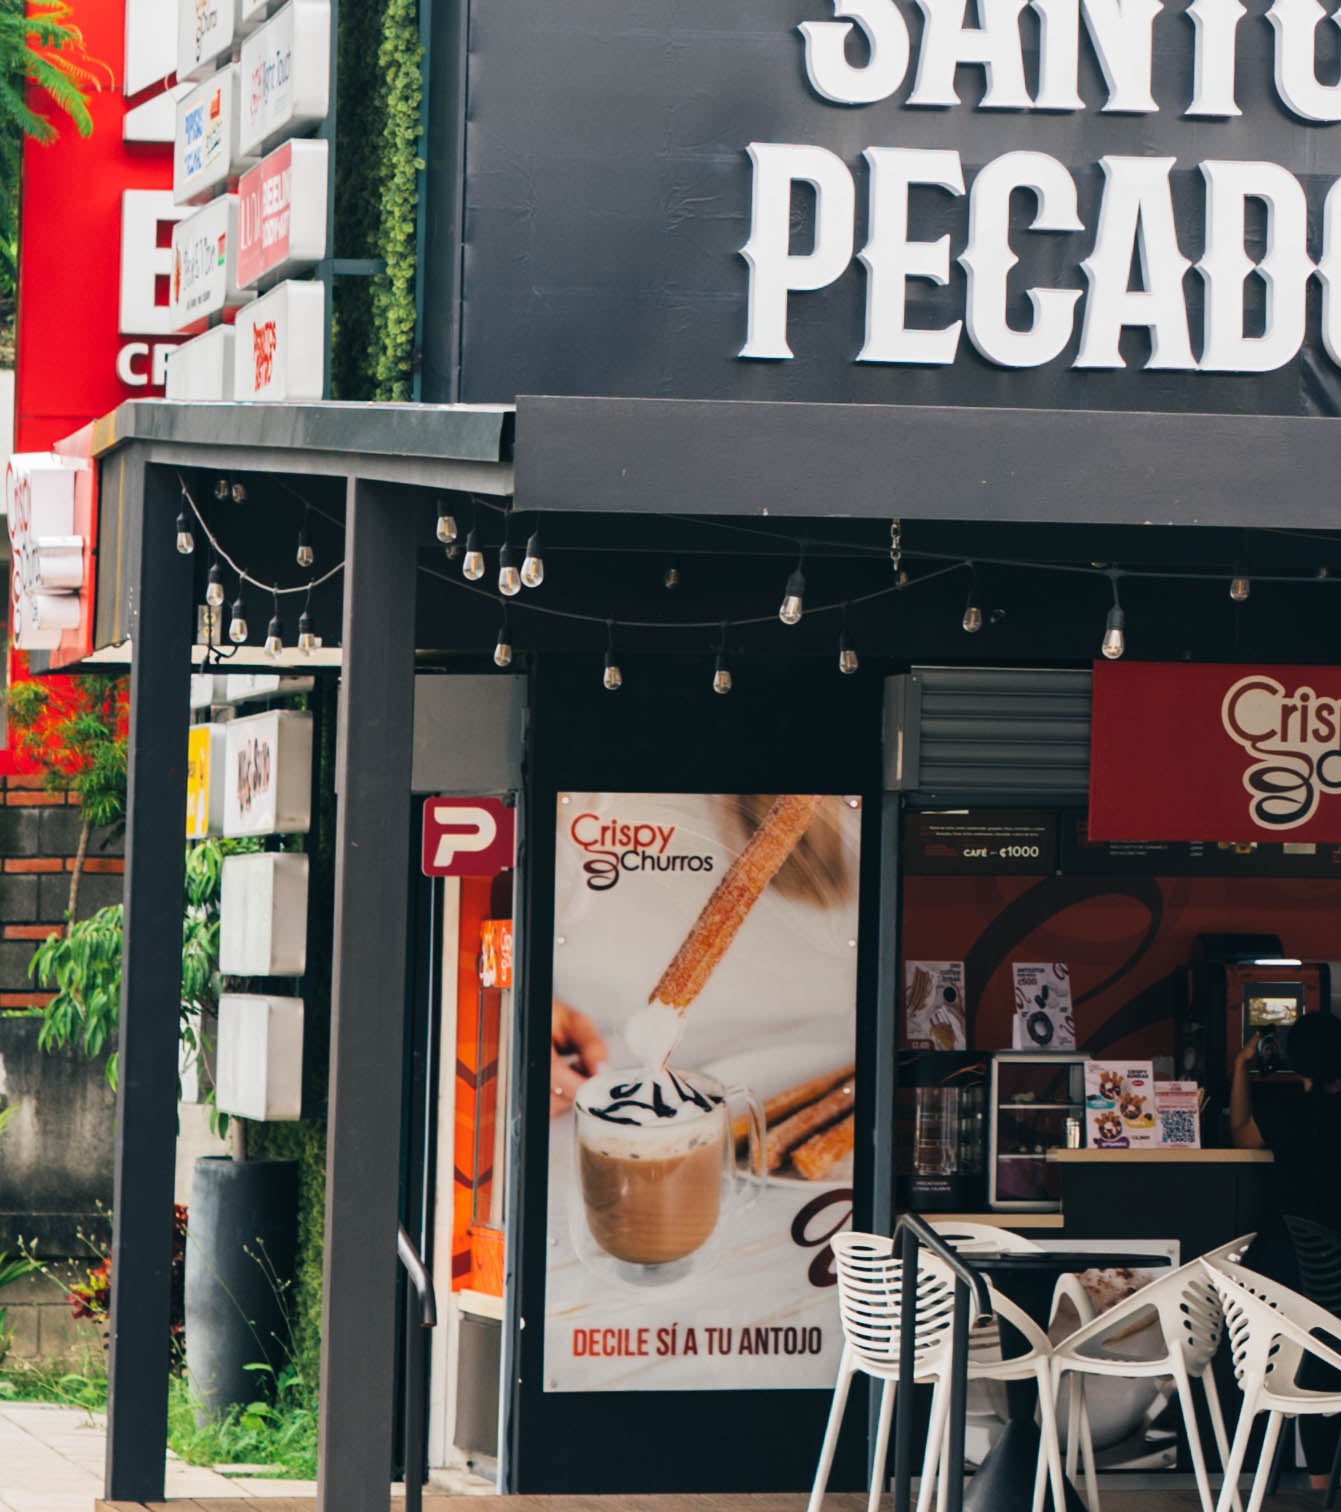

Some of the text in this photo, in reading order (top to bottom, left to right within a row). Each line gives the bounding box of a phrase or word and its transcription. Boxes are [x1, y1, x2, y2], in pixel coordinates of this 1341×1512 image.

[570, 812, 676, 855] Crispy
[620, 849, 714, 872] Churros
[572, 1322, 823, 1357] DECILE SÍ A TU ANTOJO
